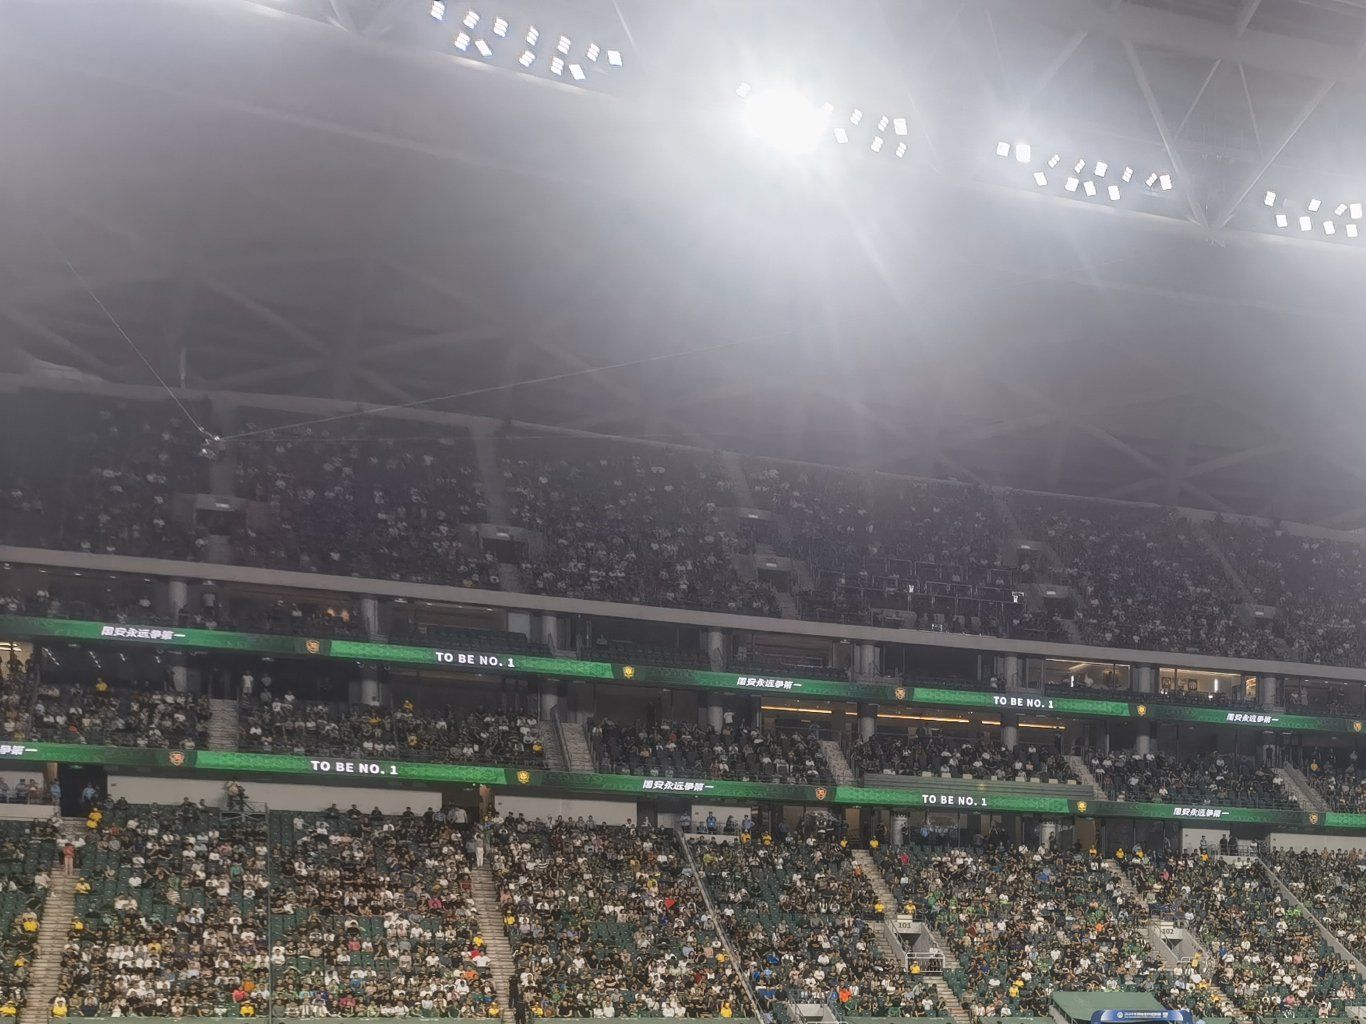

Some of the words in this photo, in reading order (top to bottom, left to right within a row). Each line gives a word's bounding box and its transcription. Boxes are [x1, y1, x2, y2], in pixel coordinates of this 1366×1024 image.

[435, 652, 454, 662] TO
[458, 654, 475, 664] BE
[480, 655, 503, 667] NO.
[508, 658, 516, 668] 1
[993, 696, 1007, 705] TO
[1010, 697, 1023, 706] BE
[1026, 699, 1045, 708] NO.
[1048, 700, 1054, 708] 1
[310, 760, 331, 771] TO
[335, 762, 354, 773] BE
[359, 763, 386, 774] NO.
[390, 765, 399, 775] 1
[922, 794, 937, 804] TO
[940, 796, 954, 805] BE
[958, 797, 978, 806] NO.
[981, 798, 988, 807] 1
